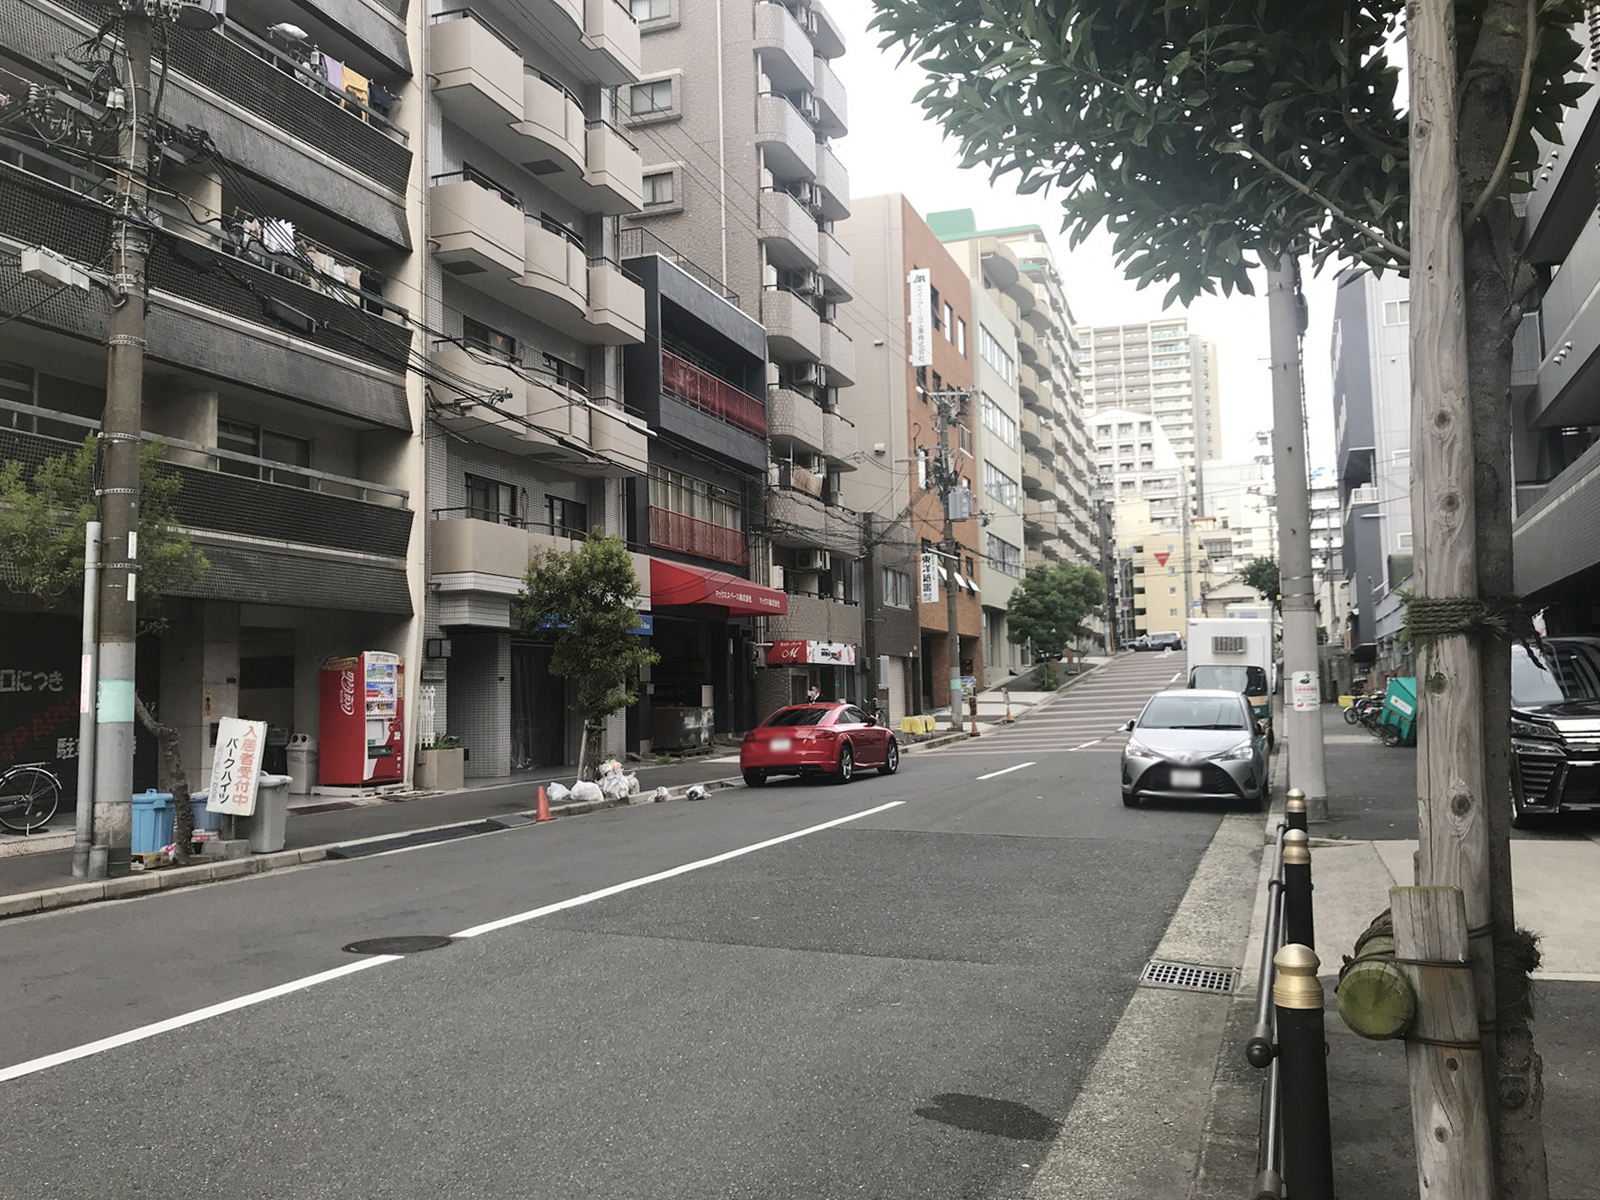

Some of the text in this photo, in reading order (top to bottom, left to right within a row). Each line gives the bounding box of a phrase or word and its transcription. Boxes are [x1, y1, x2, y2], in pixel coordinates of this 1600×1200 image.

[781, 646, 801, 659] M
[218, 737, 239, 804] パークハイツ
[232, 725, 258, 807] 入居者受付中
